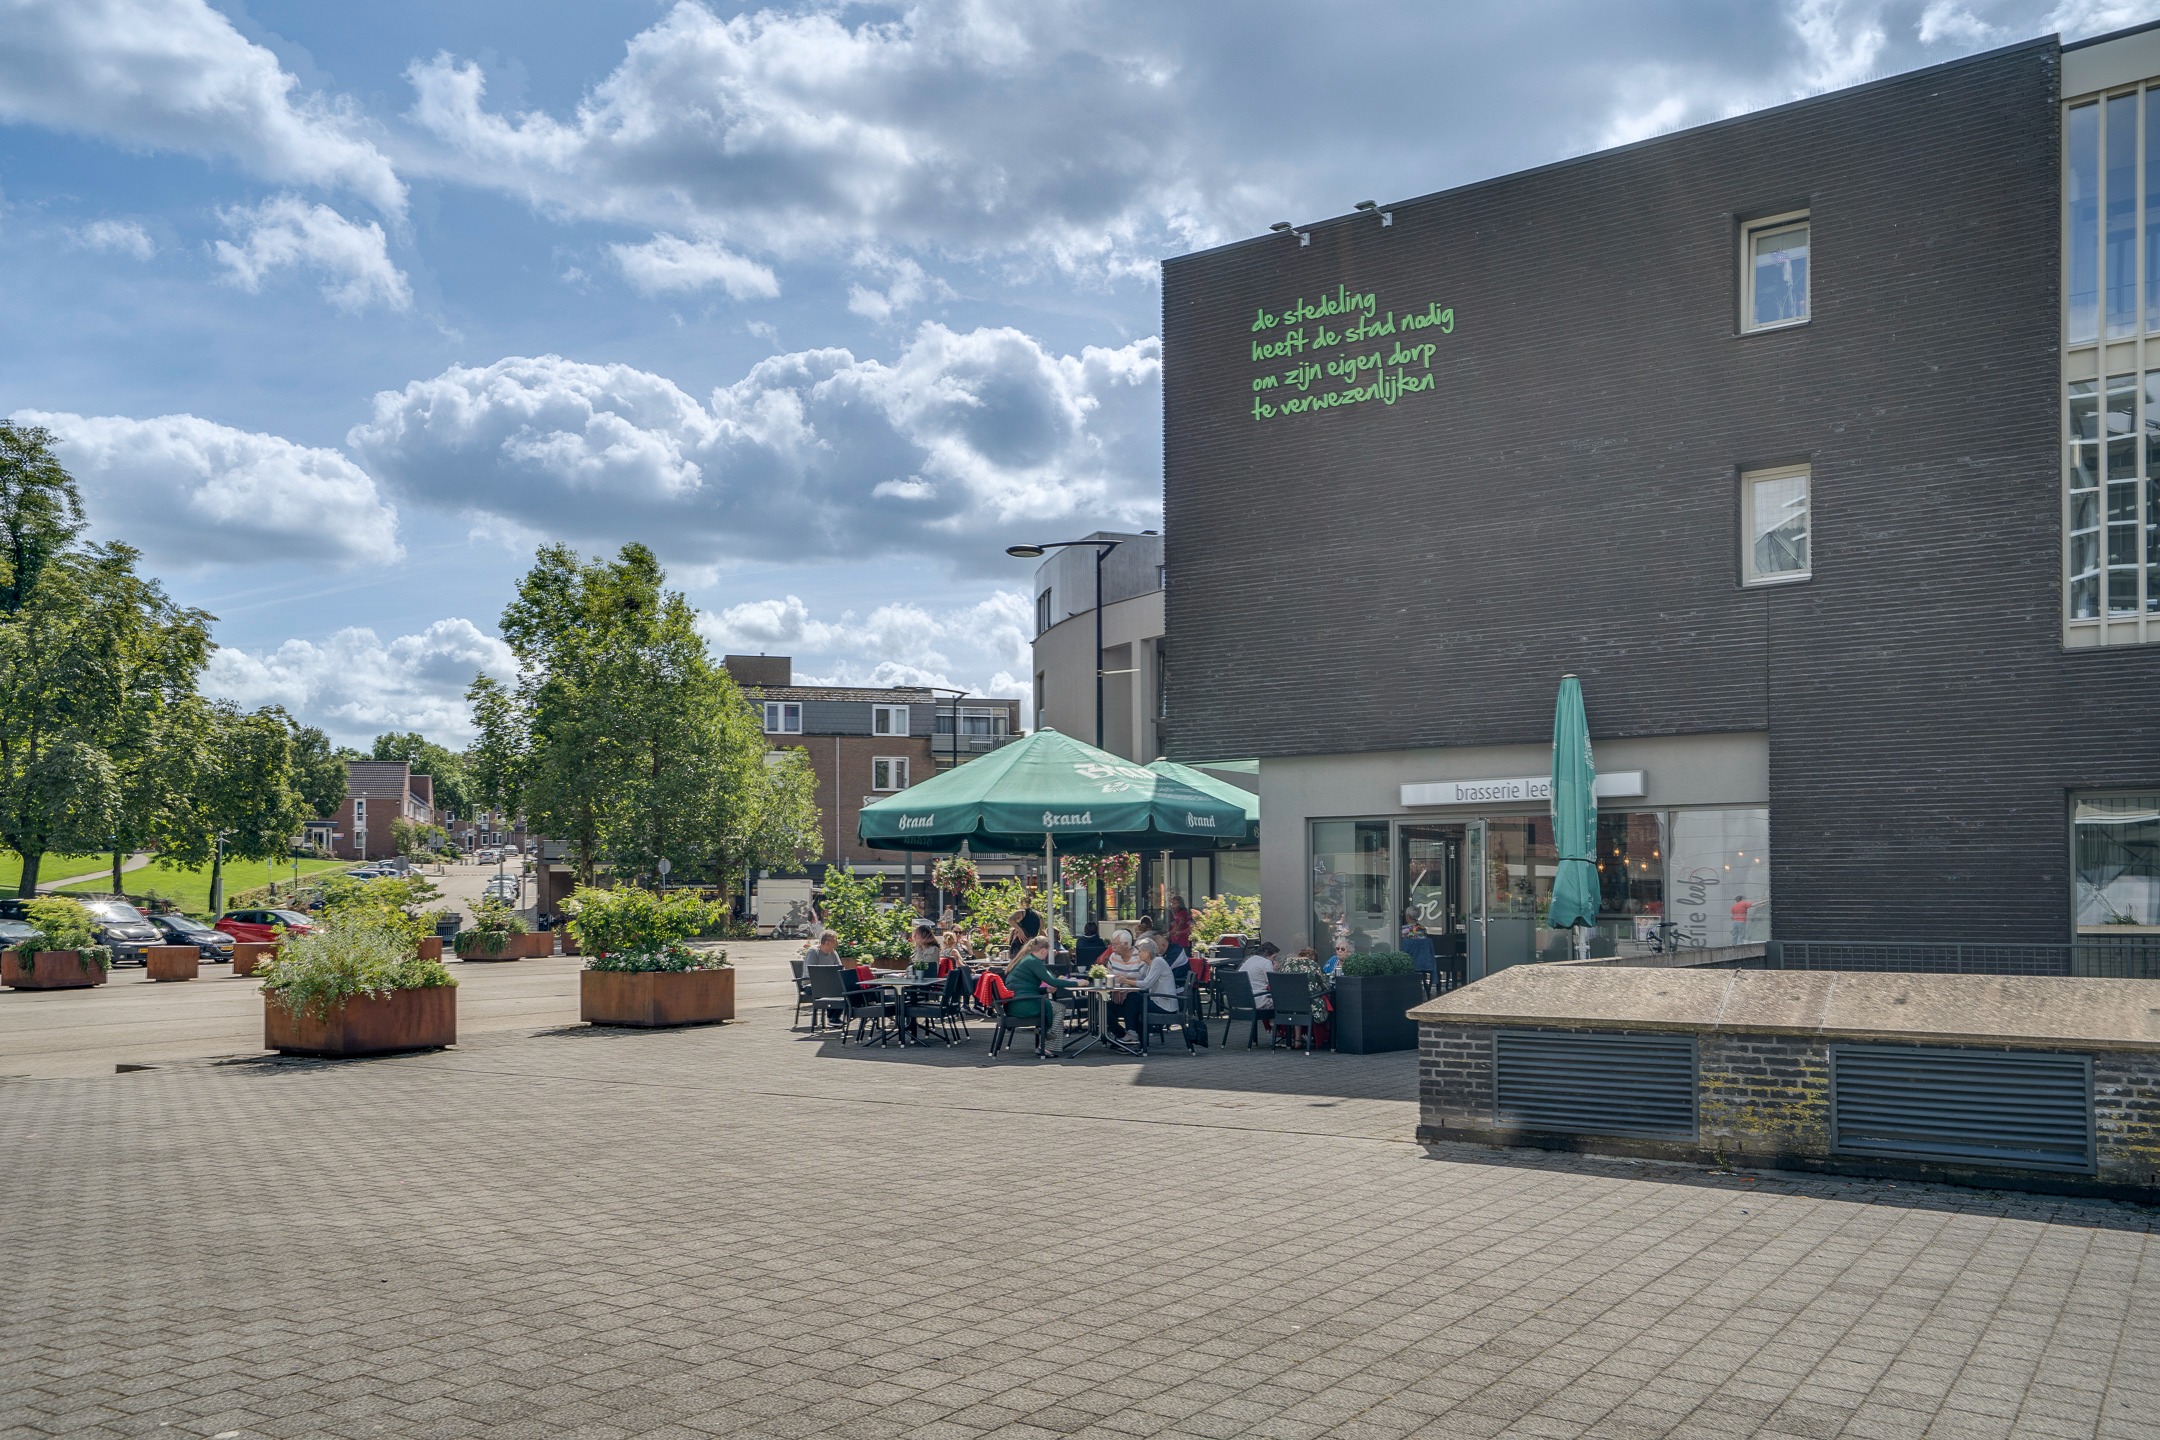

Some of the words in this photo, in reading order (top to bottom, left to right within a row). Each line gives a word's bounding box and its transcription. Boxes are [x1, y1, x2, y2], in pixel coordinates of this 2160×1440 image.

[1251, 308, 1279, 332] de
[1283, 283, 1376, 325] stedeling
[1252, 328, 1309, 361] heeft
[1312, 326, 1341, 349] de
[1345, 311, 1396, 342] stad
[1401, 303, 1454, 333] nodig
[1252, 376, 1278, 391] om
[1284, 361, 1322, 390] zijn
[1327, 353, 1382, 383] eigen
[1387, 342, 1436, 368] dorp
[1252, 397, 1277, 420] te
[1280, 367, 1435, 415] verwezenlijken
[1455, 782, 1520, 801] brasserie
[898, 813, 935, 831] Brand
[1042, 810, 1092, 828] Brand
[1186, 812, 1216, 828] Brand
